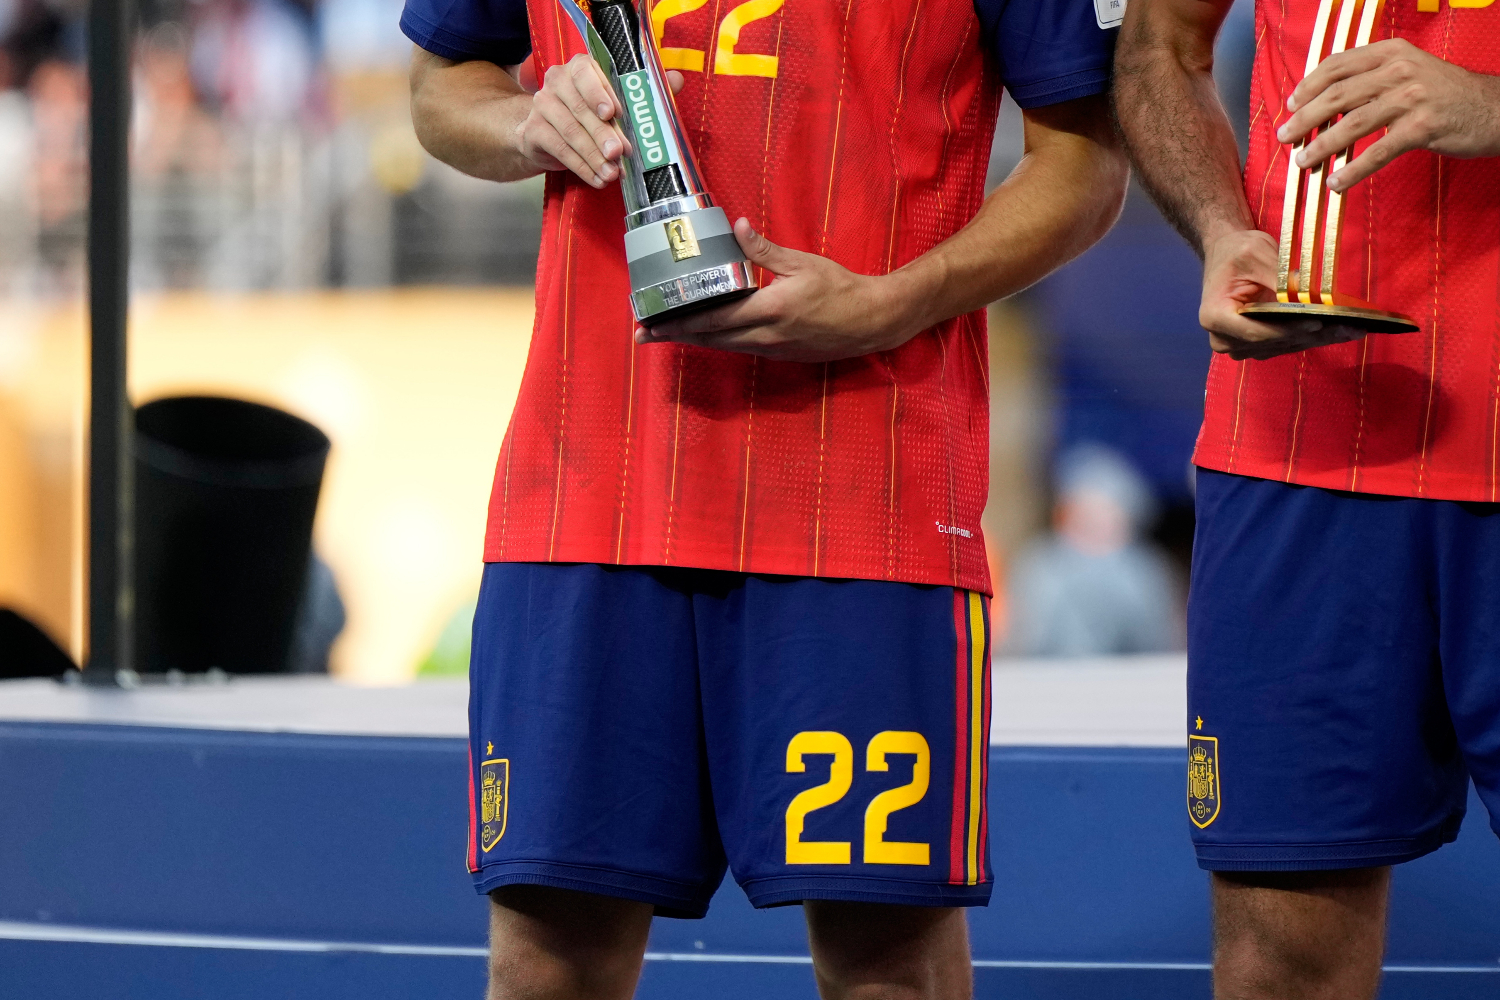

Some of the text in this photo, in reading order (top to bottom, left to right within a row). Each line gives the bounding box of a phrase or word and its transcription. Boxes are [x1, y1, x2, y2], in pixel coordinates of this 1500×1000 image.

[626, 75, 662, 163] aramco
[690, 270, 720, 284] PLAYER
[663, 295, 680, 307] THE
[938, 525, 971, 538] CLIMACOOL
[785, 730, 930, 864] 22
